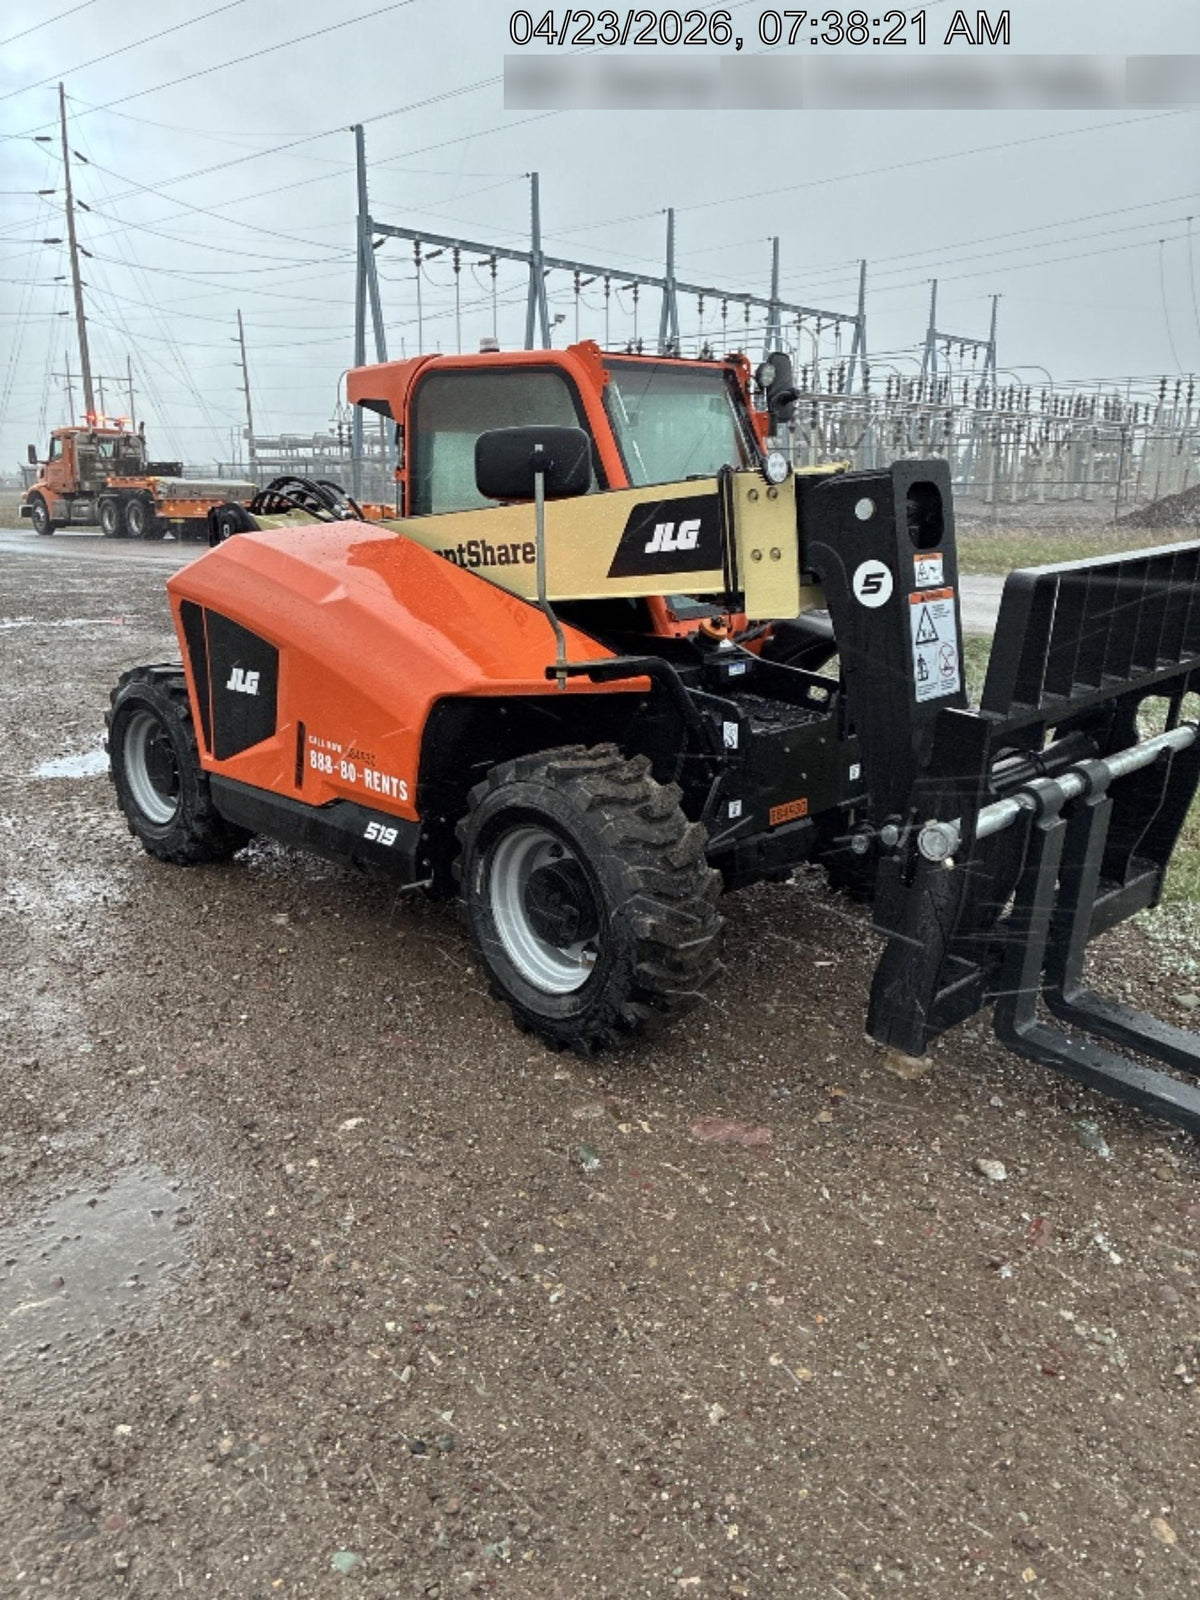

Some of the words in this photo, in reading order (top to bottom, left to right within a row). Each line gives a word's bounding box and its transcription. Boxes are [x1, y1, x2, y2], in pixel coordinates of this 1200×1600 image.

[645, 519, 702, 554] JLG
[433, 540, 536, 568] ntShare
[225, 668, 260, 695] JLG
[308, 735, 325, 748] CALL
[309, 750, 408, 801] 888-80-RENTS
[364, 821, 399, 846] 519
